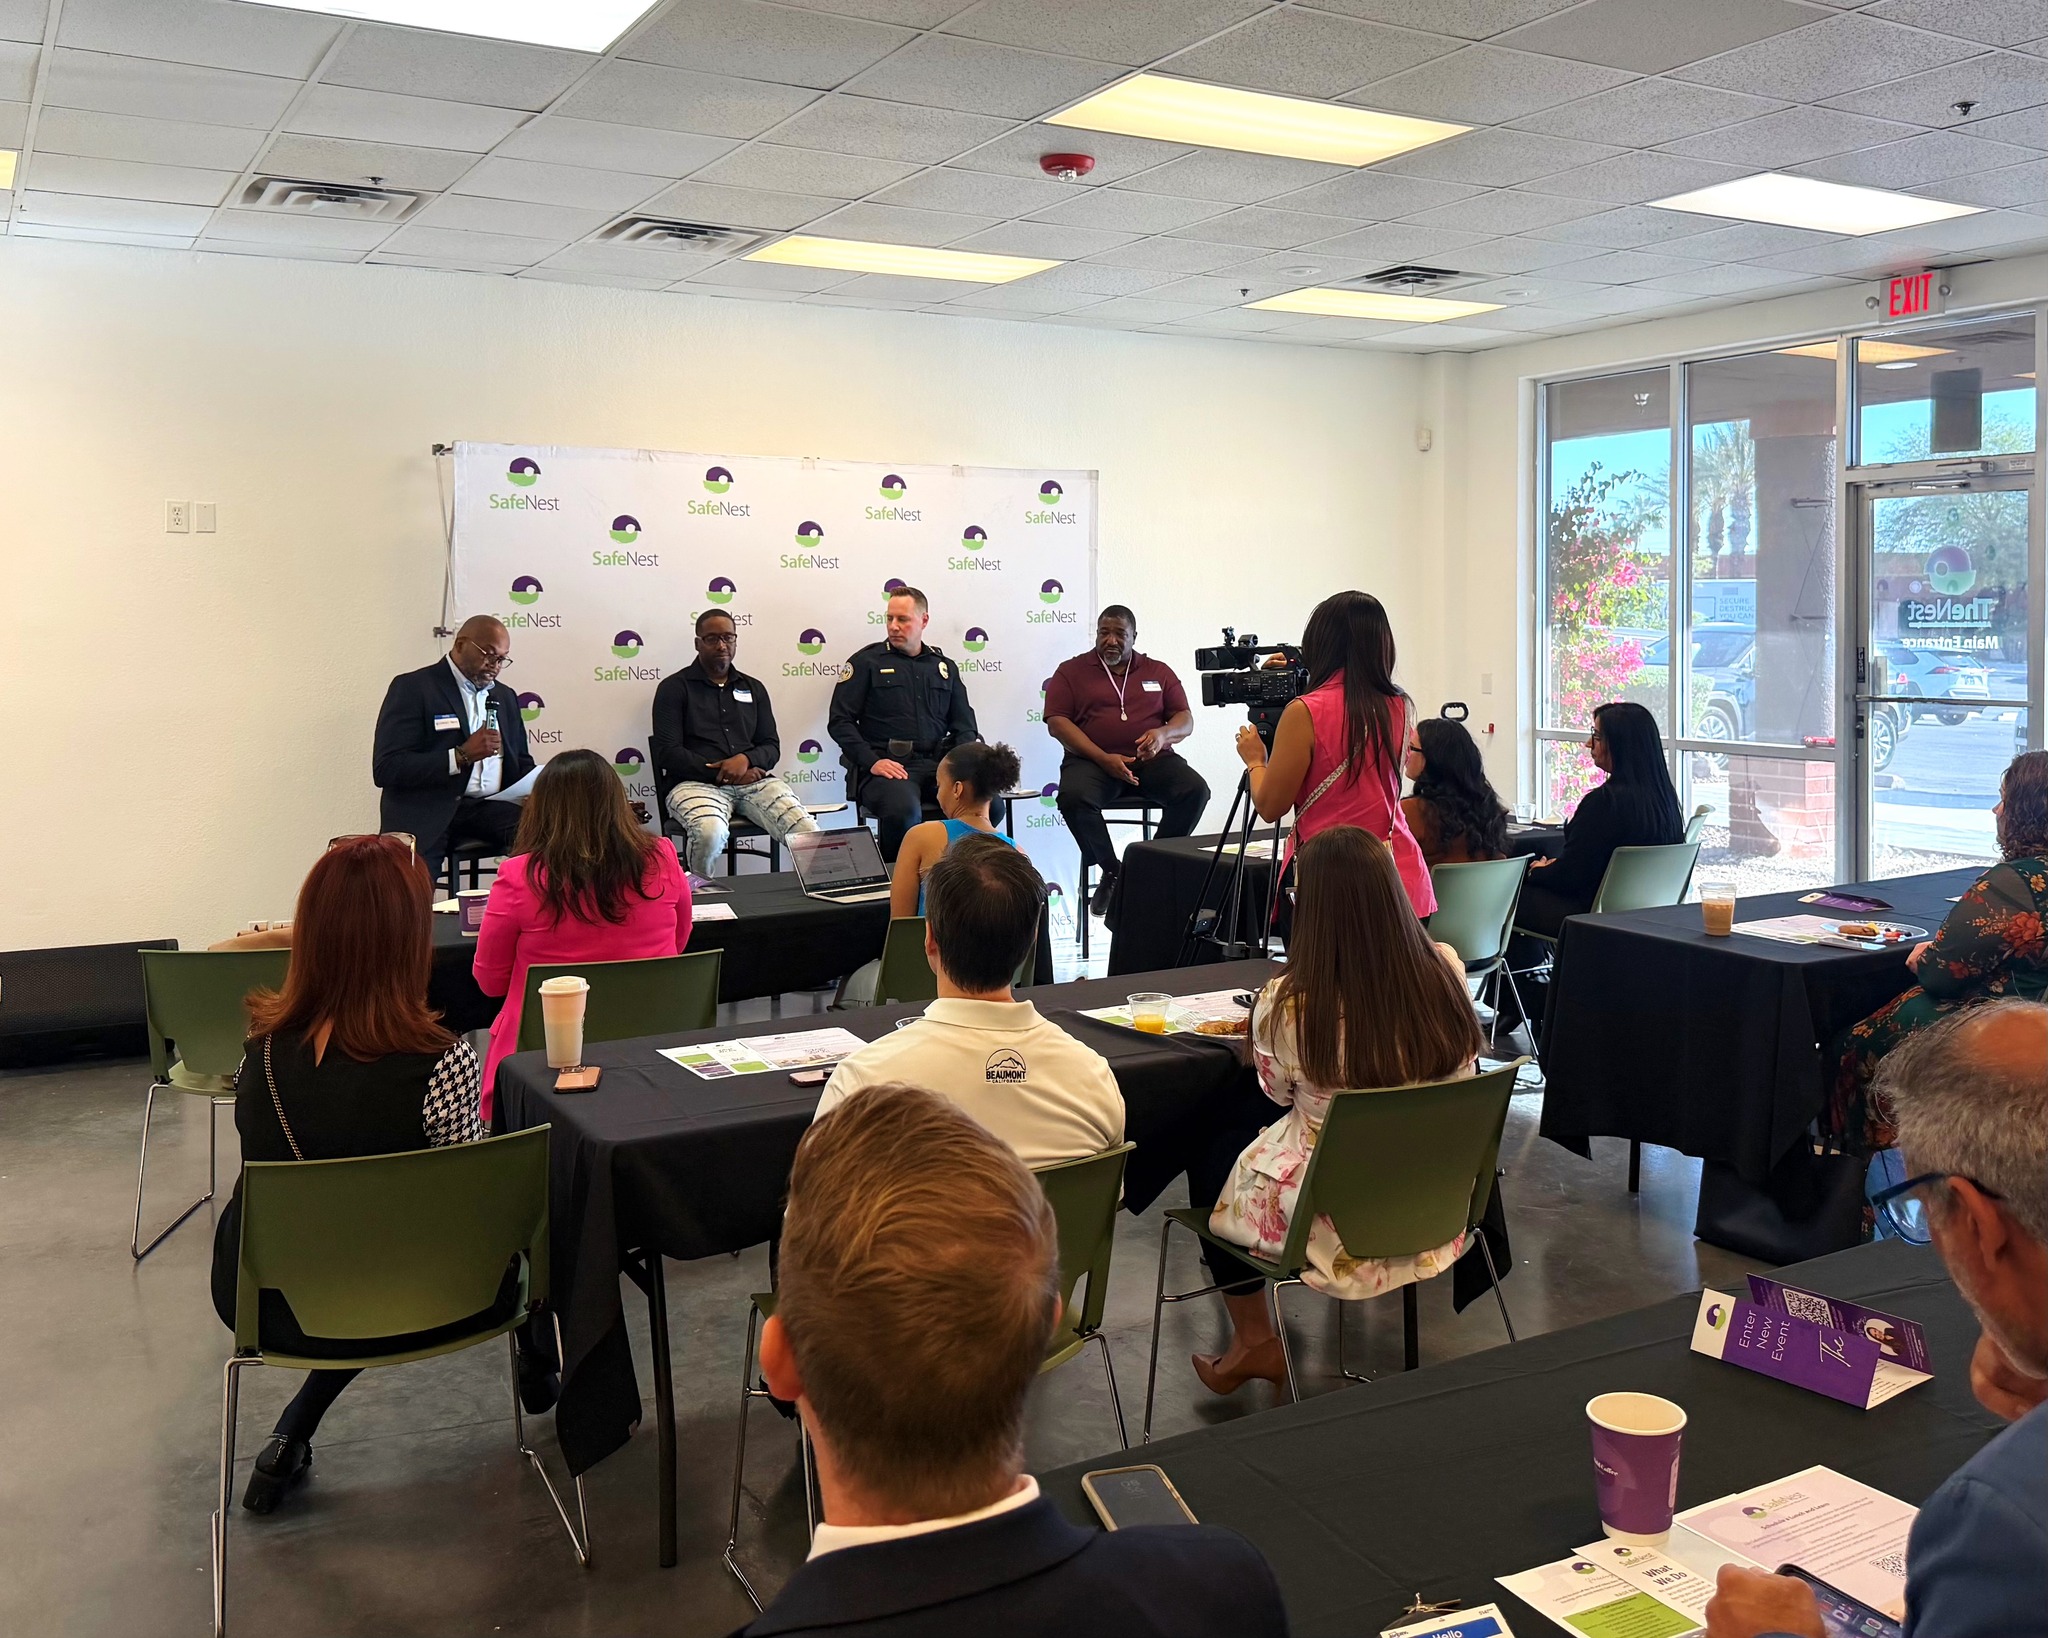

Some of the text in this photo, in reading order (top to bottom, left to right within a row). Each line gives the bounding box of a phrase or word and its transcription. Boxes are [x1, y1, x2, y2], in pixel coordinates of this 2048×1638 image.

[1889, 273, 1934, 318] EXIT
[489, 494, 560, 511] SafeNest
[687, 500, 750, 517] SafeNest
[865, 506, 922, 522] SafeNest
[1025, 511, 1076, 524] SafeNest
[592, 551, 659, 567] SafeNest
[780, 554, 839, 569] SafeNest
[947, 557, 1001, 571] SafeNest
[1026, 610, 1077, 623] SafeNest
[782, 662, 840, 677] SafeNest
[957, 658, 1003, 672] afeNest
[594, 666, 661, 681] SafeNest
[528, 728, 563, 744] Nest
[783, 769, 836, 784] SafeNest
[1026, 813, 1067, 828] SafeNe
[986, 1070, 1026, 1079] BEAUMONT
[1738, 1309, 1757, 1349] Enter
[1756, 1316, 1773, 1350] New
[1771, 1320, 1791, 1362] Event
[1818, 1330, 1852, 1368] The
[1641, 1564, 1673, 1578] What
[1653, 1571, 1688, 1586] We Do
